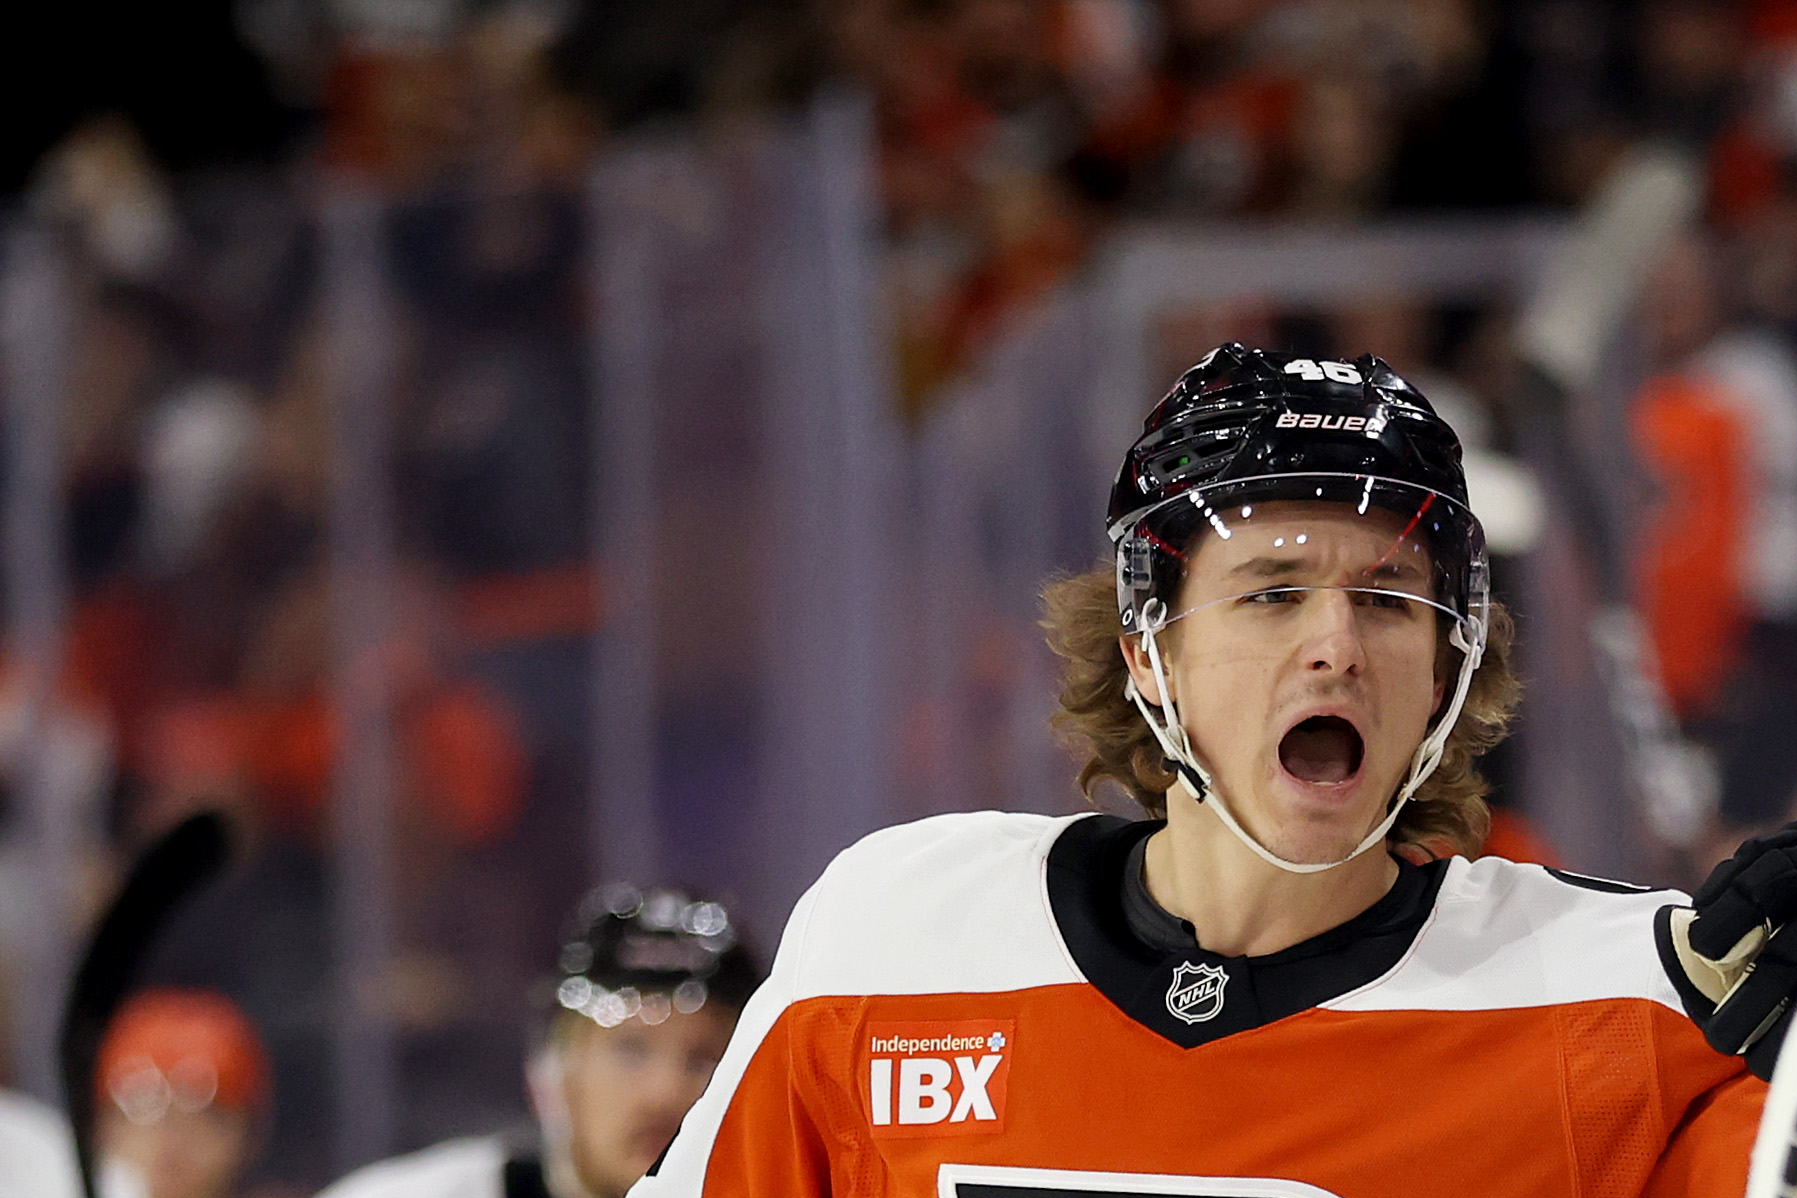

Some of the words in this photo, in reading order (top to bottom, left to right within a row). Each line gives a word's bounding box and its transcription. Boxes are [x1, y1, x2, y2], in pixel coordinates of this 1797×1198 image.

[1283, 358, 1363, 385] 46
[1178, 980, 1215, 1008] NHL
[871, 1033, 984, 1056] Independence
[870, 1054, 1003, 1126] IBX
